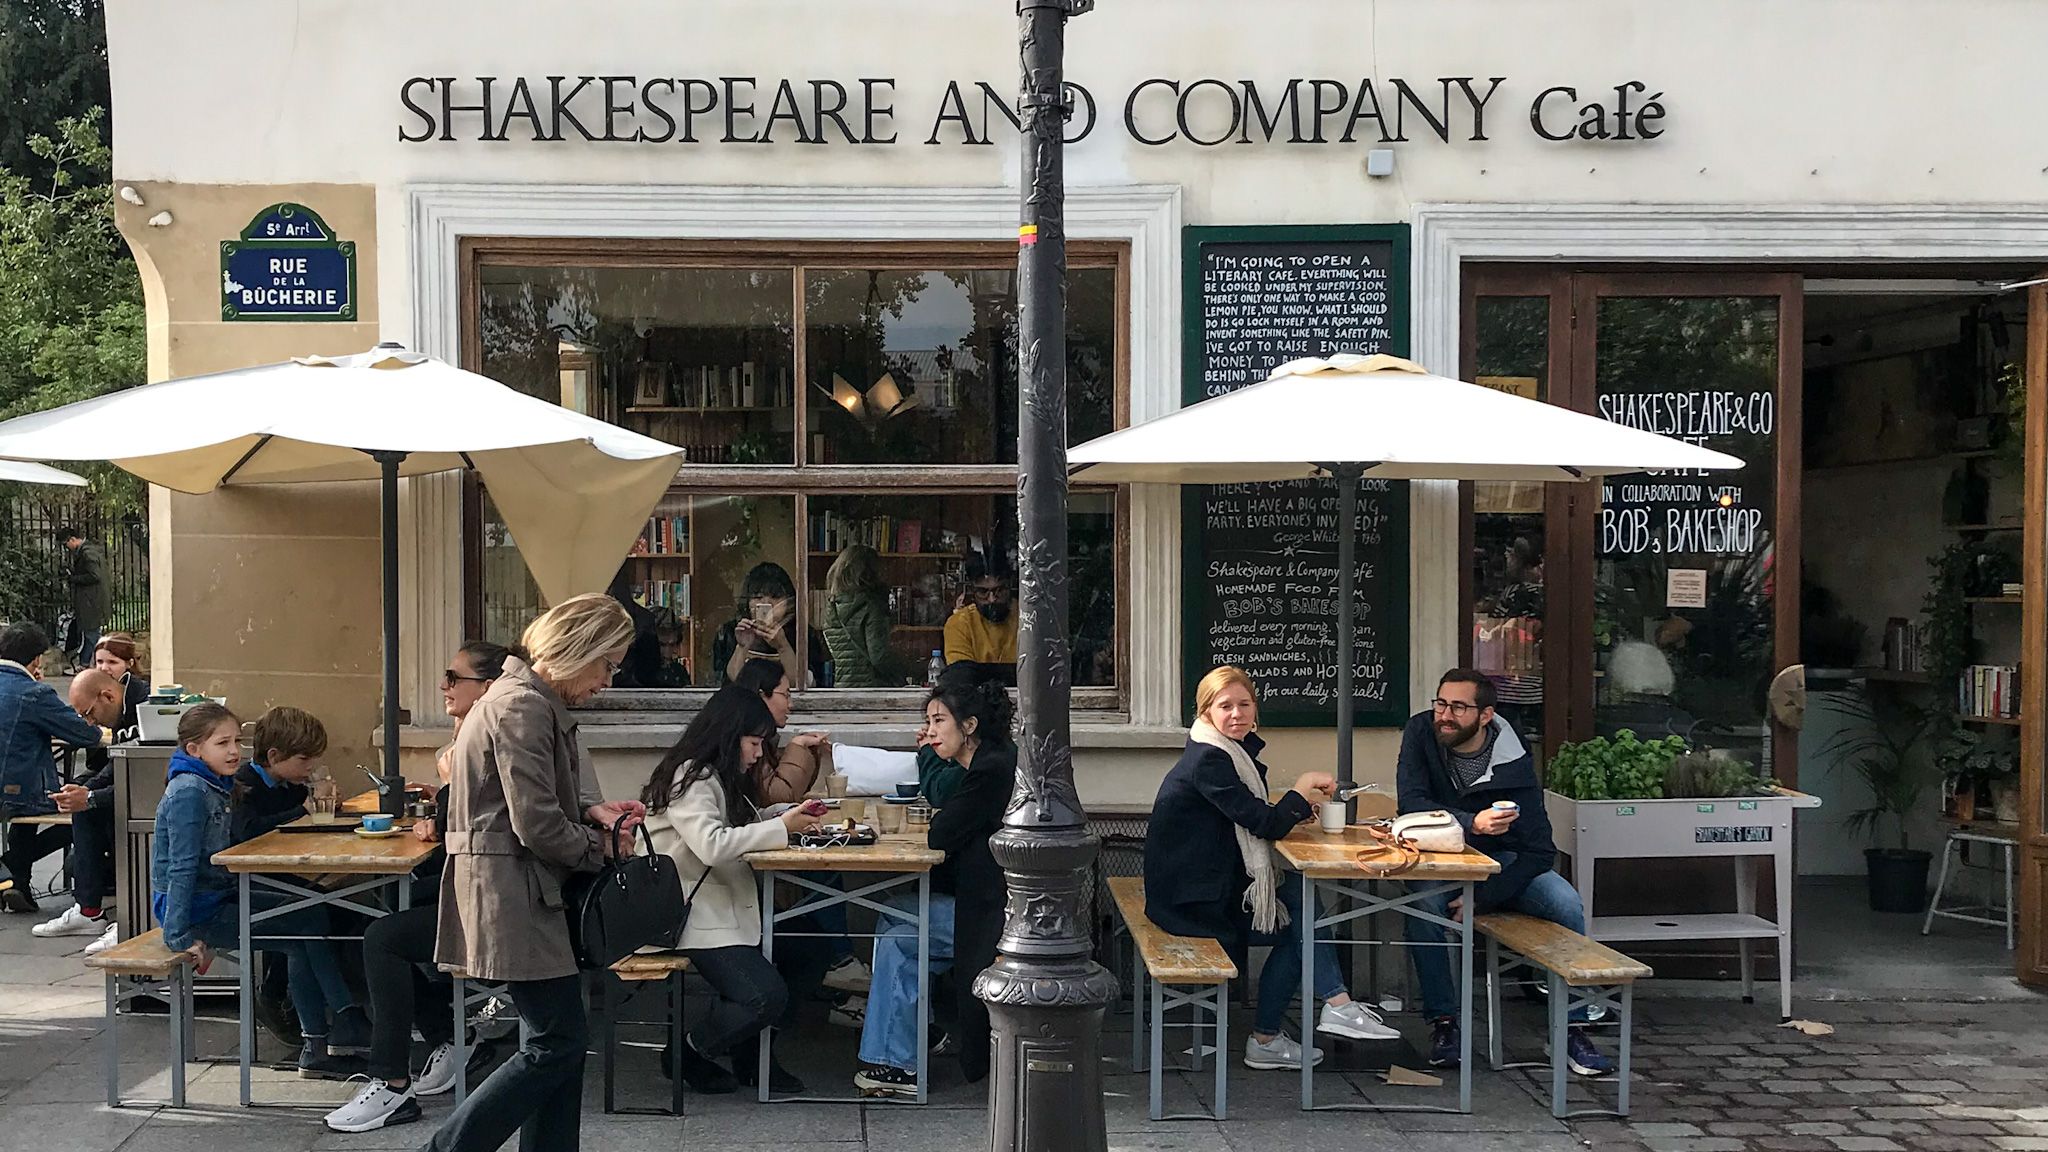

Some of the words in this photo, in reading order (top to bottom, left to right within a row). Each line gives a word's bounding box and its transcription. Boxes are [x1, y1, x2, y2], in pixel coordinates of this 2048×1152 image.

[398, 76, 898, 145] SHAKESPEARE
[924, 80, 1097, 145] AND
[1123, 76, 1506, 146] COMPANY
[1529, 80, 1666, 142] Café
[269, 258, 308, 274] RUE
[1240, 256, 1283, 270] GOING
[1288, 256, 1306, 266] TO
[1312, 255, 1351, 266] OPEN
[1360, 255, 1371, 266] A
[273, 277, 287, 286] DE
[293, 277, 306, 286] LA
[1204, 270, 1263, 282] LITERARY
[1300, 269, 1359, 280] EVERYTHING
[1362, 269, 1387, 279] WILL
[1204, 283, 1217, 293] BE
[1220, 282, 1261, 293] COOKED
[1265, 282, 1297, 292] UNDER
[1299, 282, 1312, 292] MY
[1315, 281, 1387, 292] SUPERVISION.
[242, 286, 337, 305] BÛCHERIE
[1203, 294, 1238, 305] THERE'S
[1240, 293, 1262, 304] ONLY
[1263, 293, 1281, 303] ONE
[1283, 293, 1300, 303] WAY
[1304, 293, 1316, 302] TO
[1318, 292, 1345, 302] MAKE
[1348, 292, 1356, 302] A
[1358, 291, 1386, 302] GOOD
[1205, 305, 1238, 317] LEMON
[1282, 305, 1313, 315] KNOW.
[1315, 304, 1342, 315] WHAT
[1342, 305, 1348, 315] I
[1350, 304, 1387, 315] SHOULD
[1205, 318, 1218, 328] DO
[1220, 317, 1229, 328] IS
[1231, 318, 1244, 328] GO
[1247, 317, 1270, 327] LOCK
[1273, 317, 1305, 327] MYSELF
[1308, 317, 1319, 326] IN
[1321, 317, 1329, 326] A
[1331, 316, 1359, 326] ROOM
[1362, 315, 1383, 326] AND
[1205, 328, 1237, 340] INVENT
[1240, 328, 1288, 339] SOMETHING
[1291, 328, 1310, 338] LIKE
[1312, 328, 1330, 338] THE
[1334, 328, 1368, 339] SAFETY
[1371, 328, 1391, 339] PIN.
[1205, 342, 1224, 354] I'VE
[1229, 341, 1252, 353] GOT
[1257, 341, 1271, 352] TO
[1276, 340, 1308, 352] RAISE
[1320, 341, 1380, 353] ENOUGH
[1209, 355, 1254, 369] MONEY
[1261, 355, 1275, 367] TO
[1204, 369, 1247, 382] BEHIND
[1206, 385, 1231, 397] CAN
[1317, 478, 1339, 490] TAK
[1602, 485, 1613, 503] IN
[1621, 484, 1702, 502] COLLABORATION
[1707, 485, 1742, 503] WITH
[1206, 500, 1240, 514] WE'LL
[1247, 498, 1281, 513] HAVE
[1285, 499, 1294, 511] A
[1297, 497, 1317, 512] BIG
[1320, 497, 1379, 515] OPEING
[1206, 515, 1244, 530] PARTY.
[1666, 508, 1763, 554] BAKESHOP
[1273, 532, 1310, 548] George
[1285, 562, 1295, 577] &
[1297, 561, 1340, 584] Company
[1353, 561, 1375, 583] afé
[1215, 583, 1276, 597] HOMEMADE
[1284, 583, 1322, 594] FOOD
[1328, 586, 1365, 600] FM
[1223, 597, 1284, 618] BOB'S
[1290, 598, 1372, 621] BAKESOP
[1209, 619, 1256, 635] delivered
[1260, 623, 1286, 637] every
[1290, 621, 1331, 637] morning.
[1210, 635, 1266, 651] vegetarian
[1268, 634, 1283, 645] and
[1286, 633, 1336, 649] gluten-free
[1212, 653, 1244, 664] FRESH
[1246, 667, 1288, 678] SALADS
[1293, 667, 1313, 676] AND
[1263, 682, 1278, 701] for
[1281, 687, 1300, 697] our
[1302, 682, 1329, 705] daily
[1331, 682, 1387, 701] sials!
